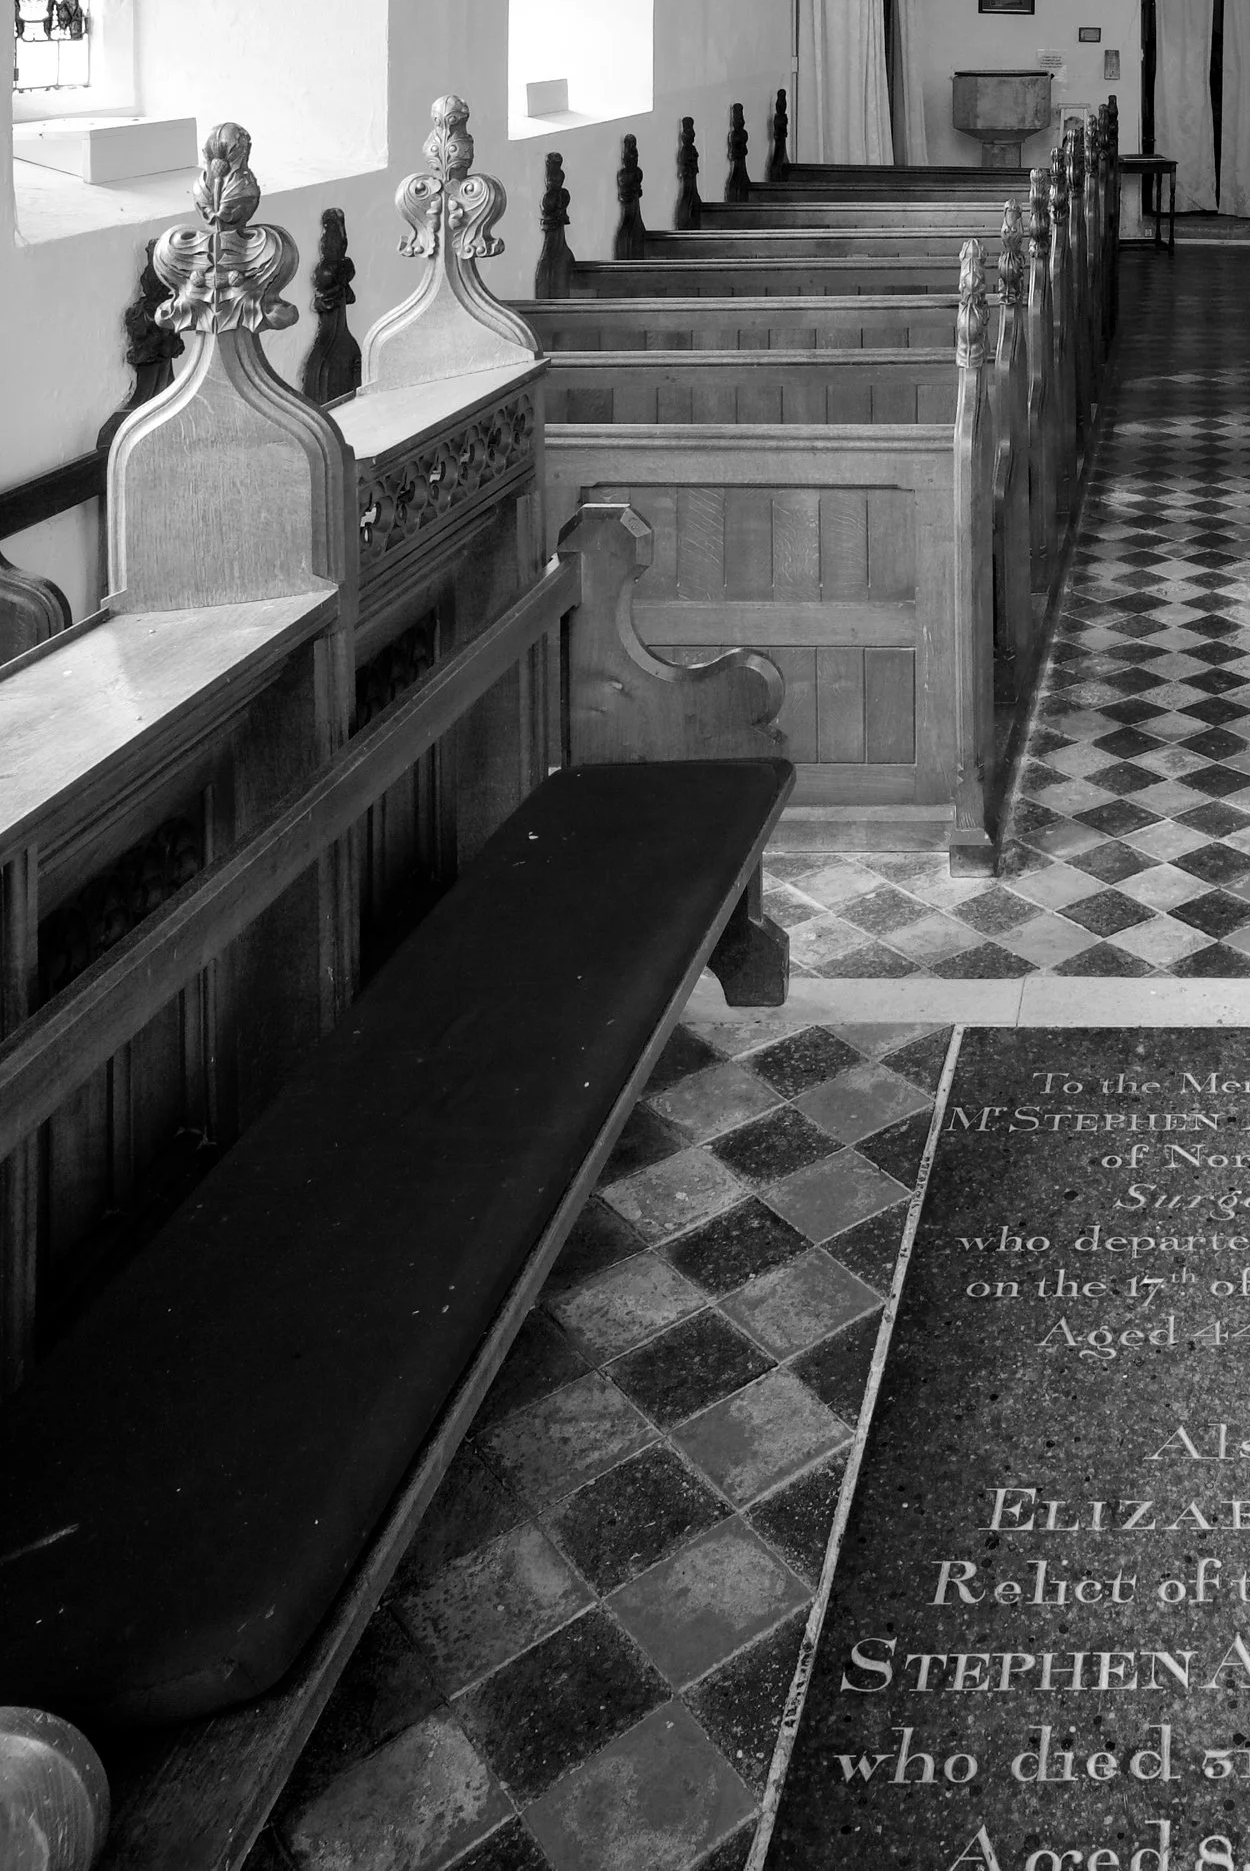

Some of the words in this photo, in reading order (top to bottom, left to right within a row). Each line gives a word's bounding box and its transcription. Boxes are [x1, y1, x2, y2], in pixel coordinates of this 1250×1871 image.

[1033, 1072, 1083, 1094] To
[1101, 1072, 1161, 1094] the
[1008, 1105, 1228, 1133] STEPHEN
[1101, 1144, 1150, 1169] of
[955, 1225, 1051, 1252] who
[965, 1279, 1021, 1298] on
[1034, 1268, 1108, 1298] the
[1034, 1315, 1180, 1360] Aged
[926, 1559, 1137, 1606] Relict
[1158, 1557, 1222, 1603] of
[840, 1637, 1199, 1693] STEPHEN
[833, 1726, 979, 1785] who
[1011, 1724, 1182, 1783] died
